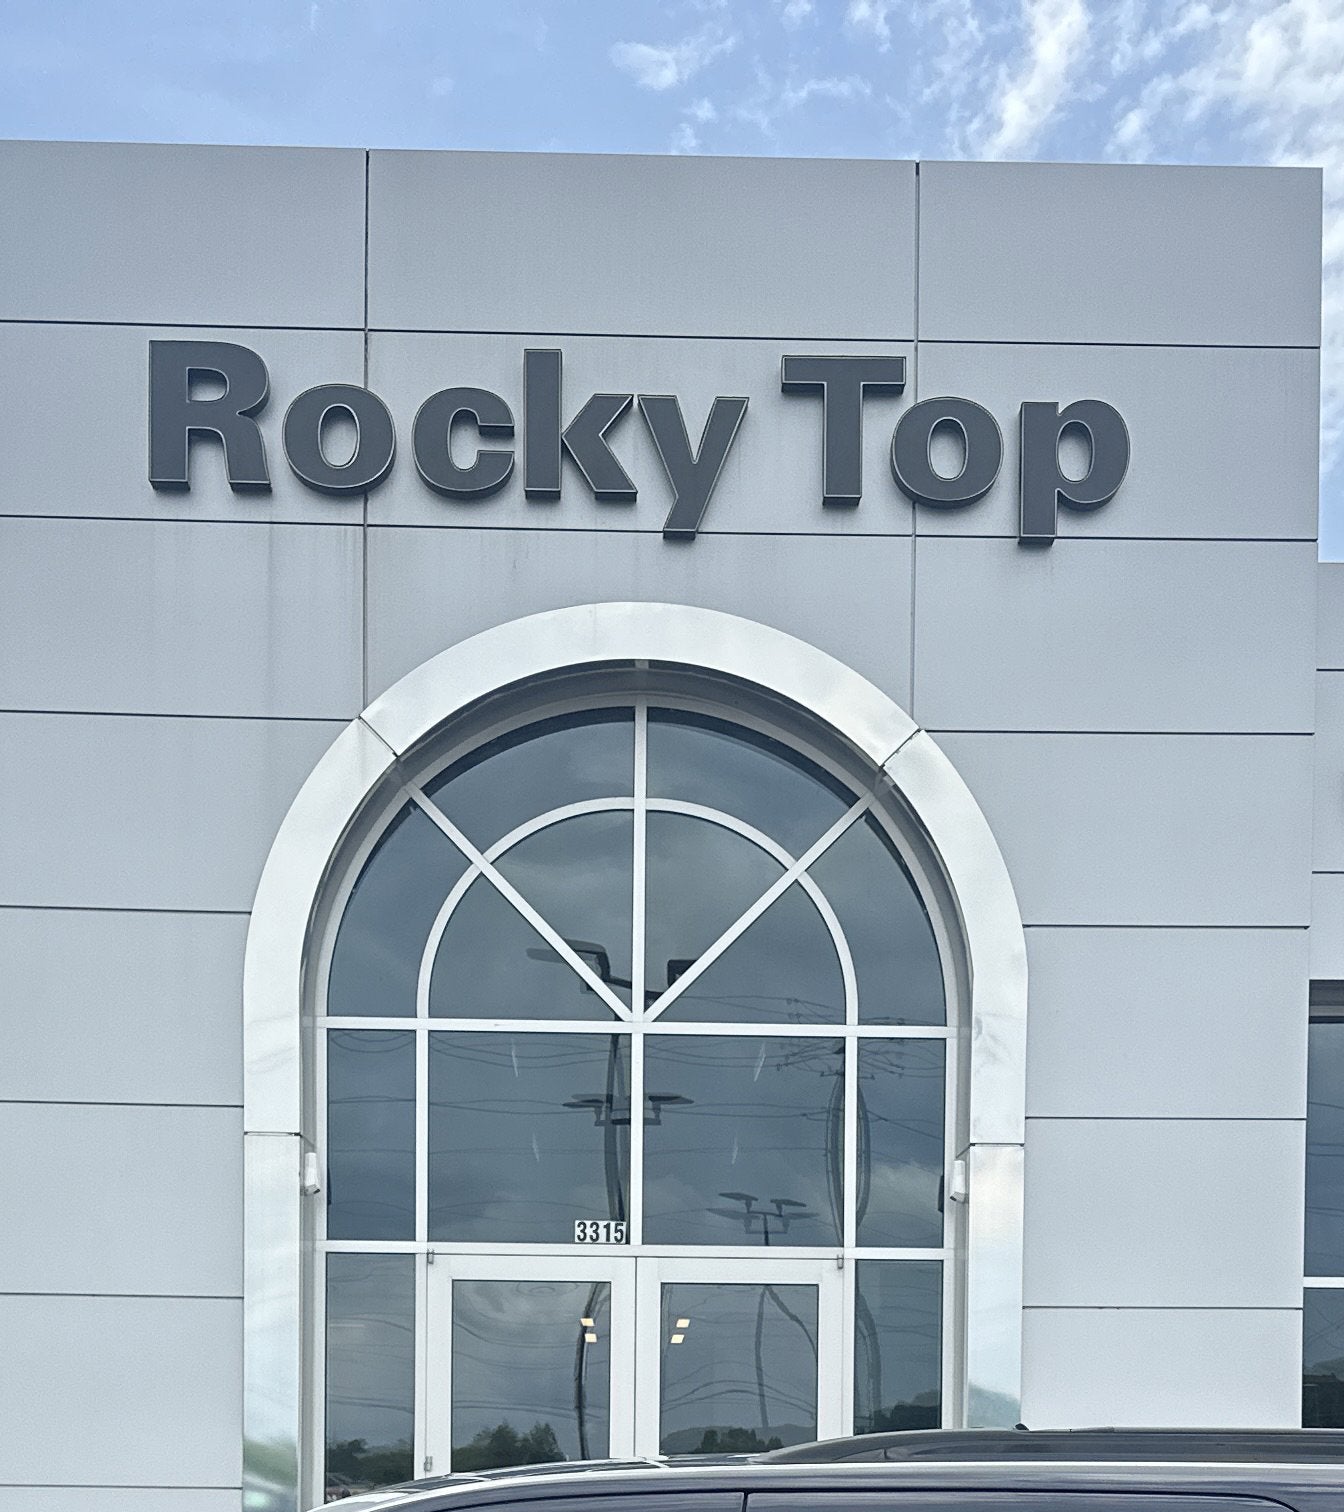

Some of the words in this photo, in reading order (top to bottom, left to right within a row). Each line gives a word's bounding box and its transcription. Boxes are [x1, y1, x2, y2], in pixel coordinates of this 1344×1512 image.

[148, 339, 751, 541] Rocky
[780, 354, 1131, 548] Top
[576, 1221, 624, 1243] 3315
